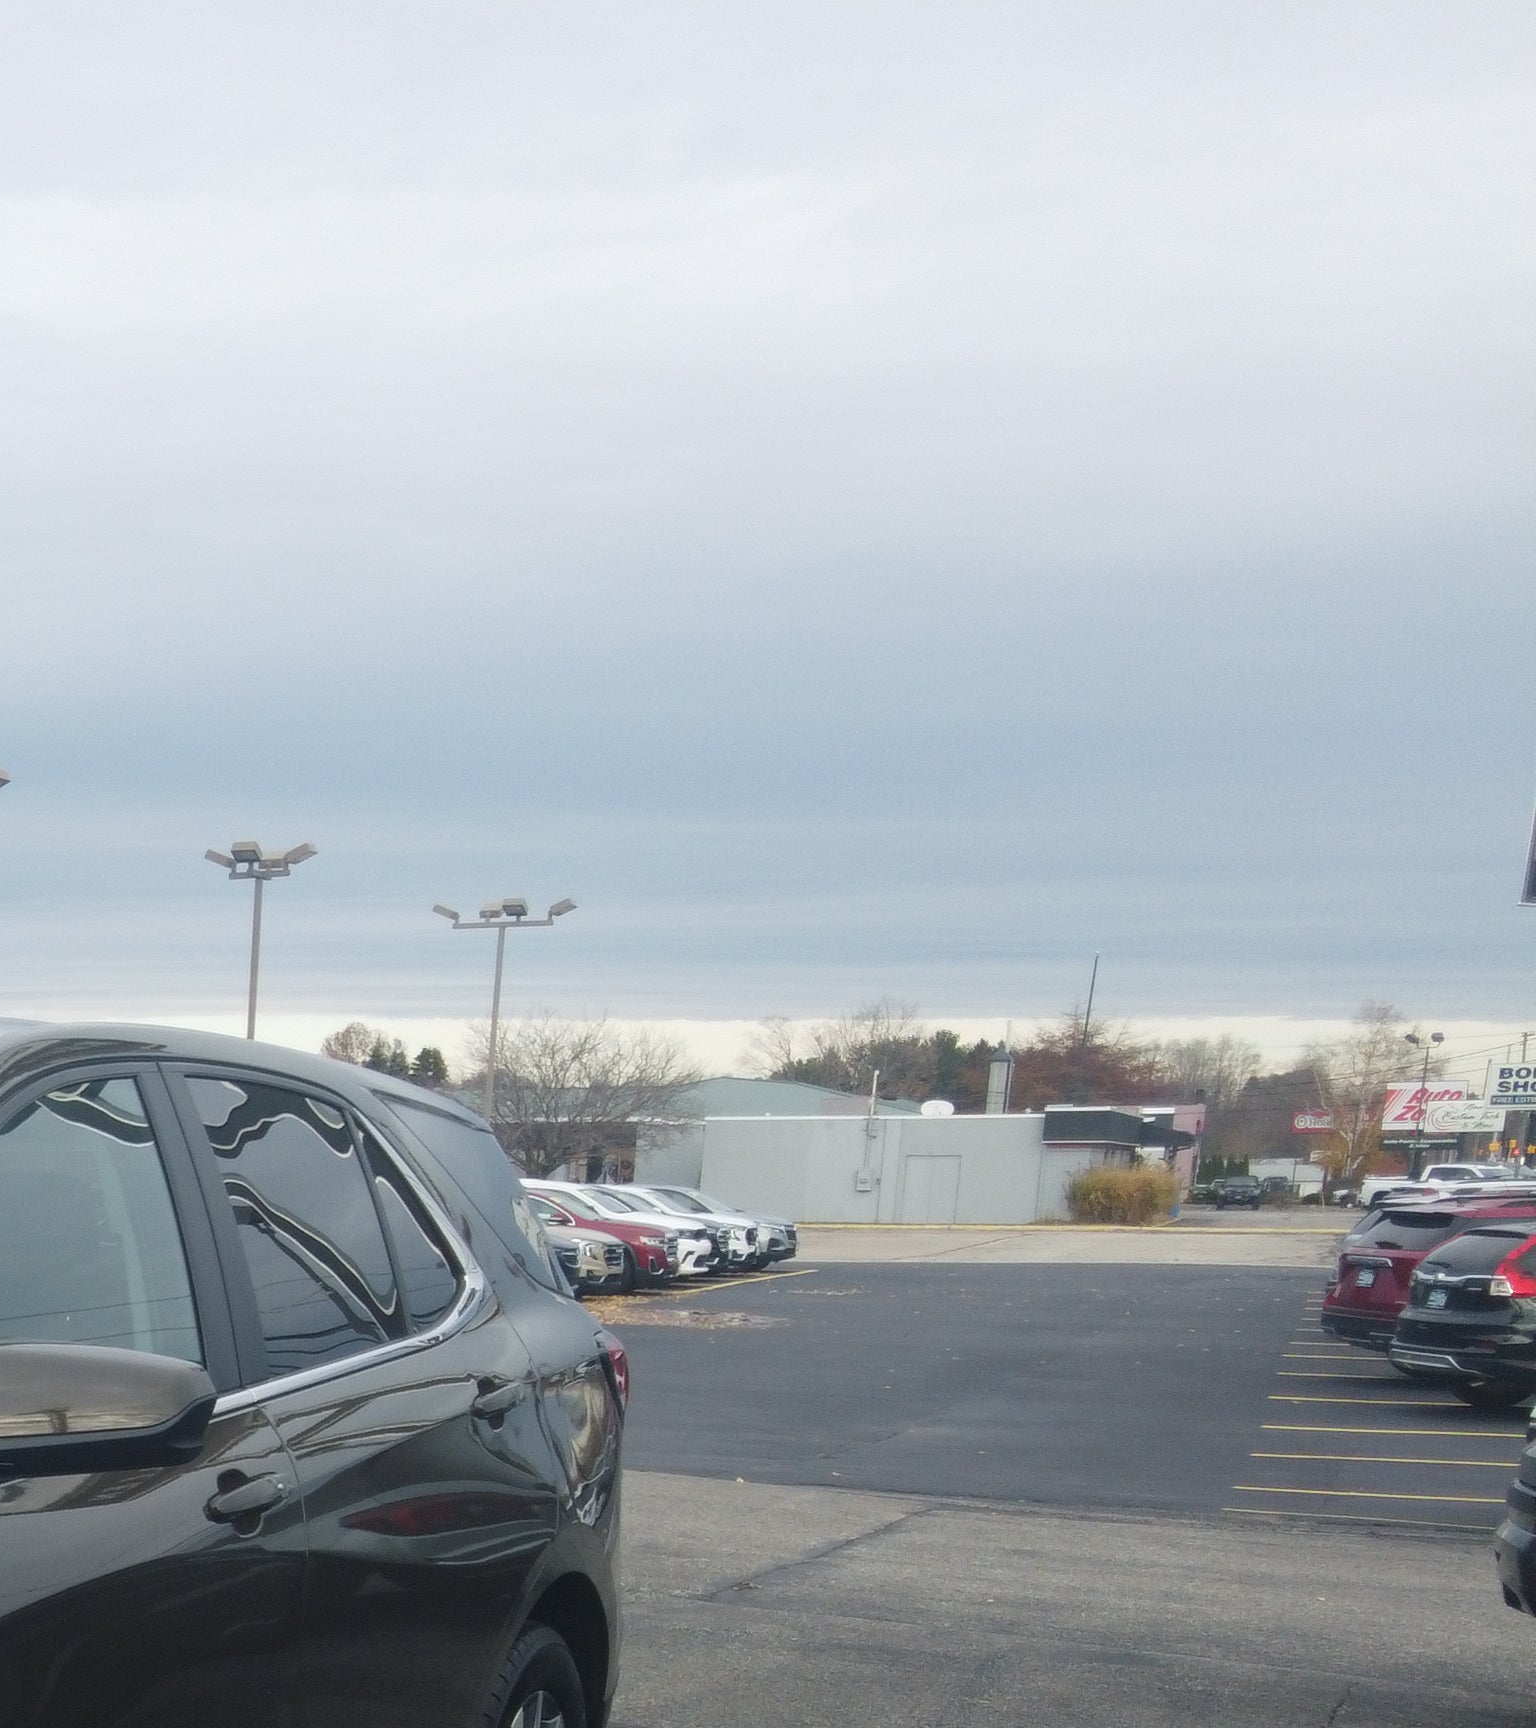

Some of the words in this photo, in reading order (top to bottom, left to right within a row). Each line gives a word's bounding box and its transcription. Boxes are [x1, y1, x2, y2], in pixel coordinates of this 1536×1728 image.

[1499, 1067, 1536, 1079] BO
[1406, 1088, 1463, 1104] Auto
[1393, 1105, 1426, 1121] Zo
